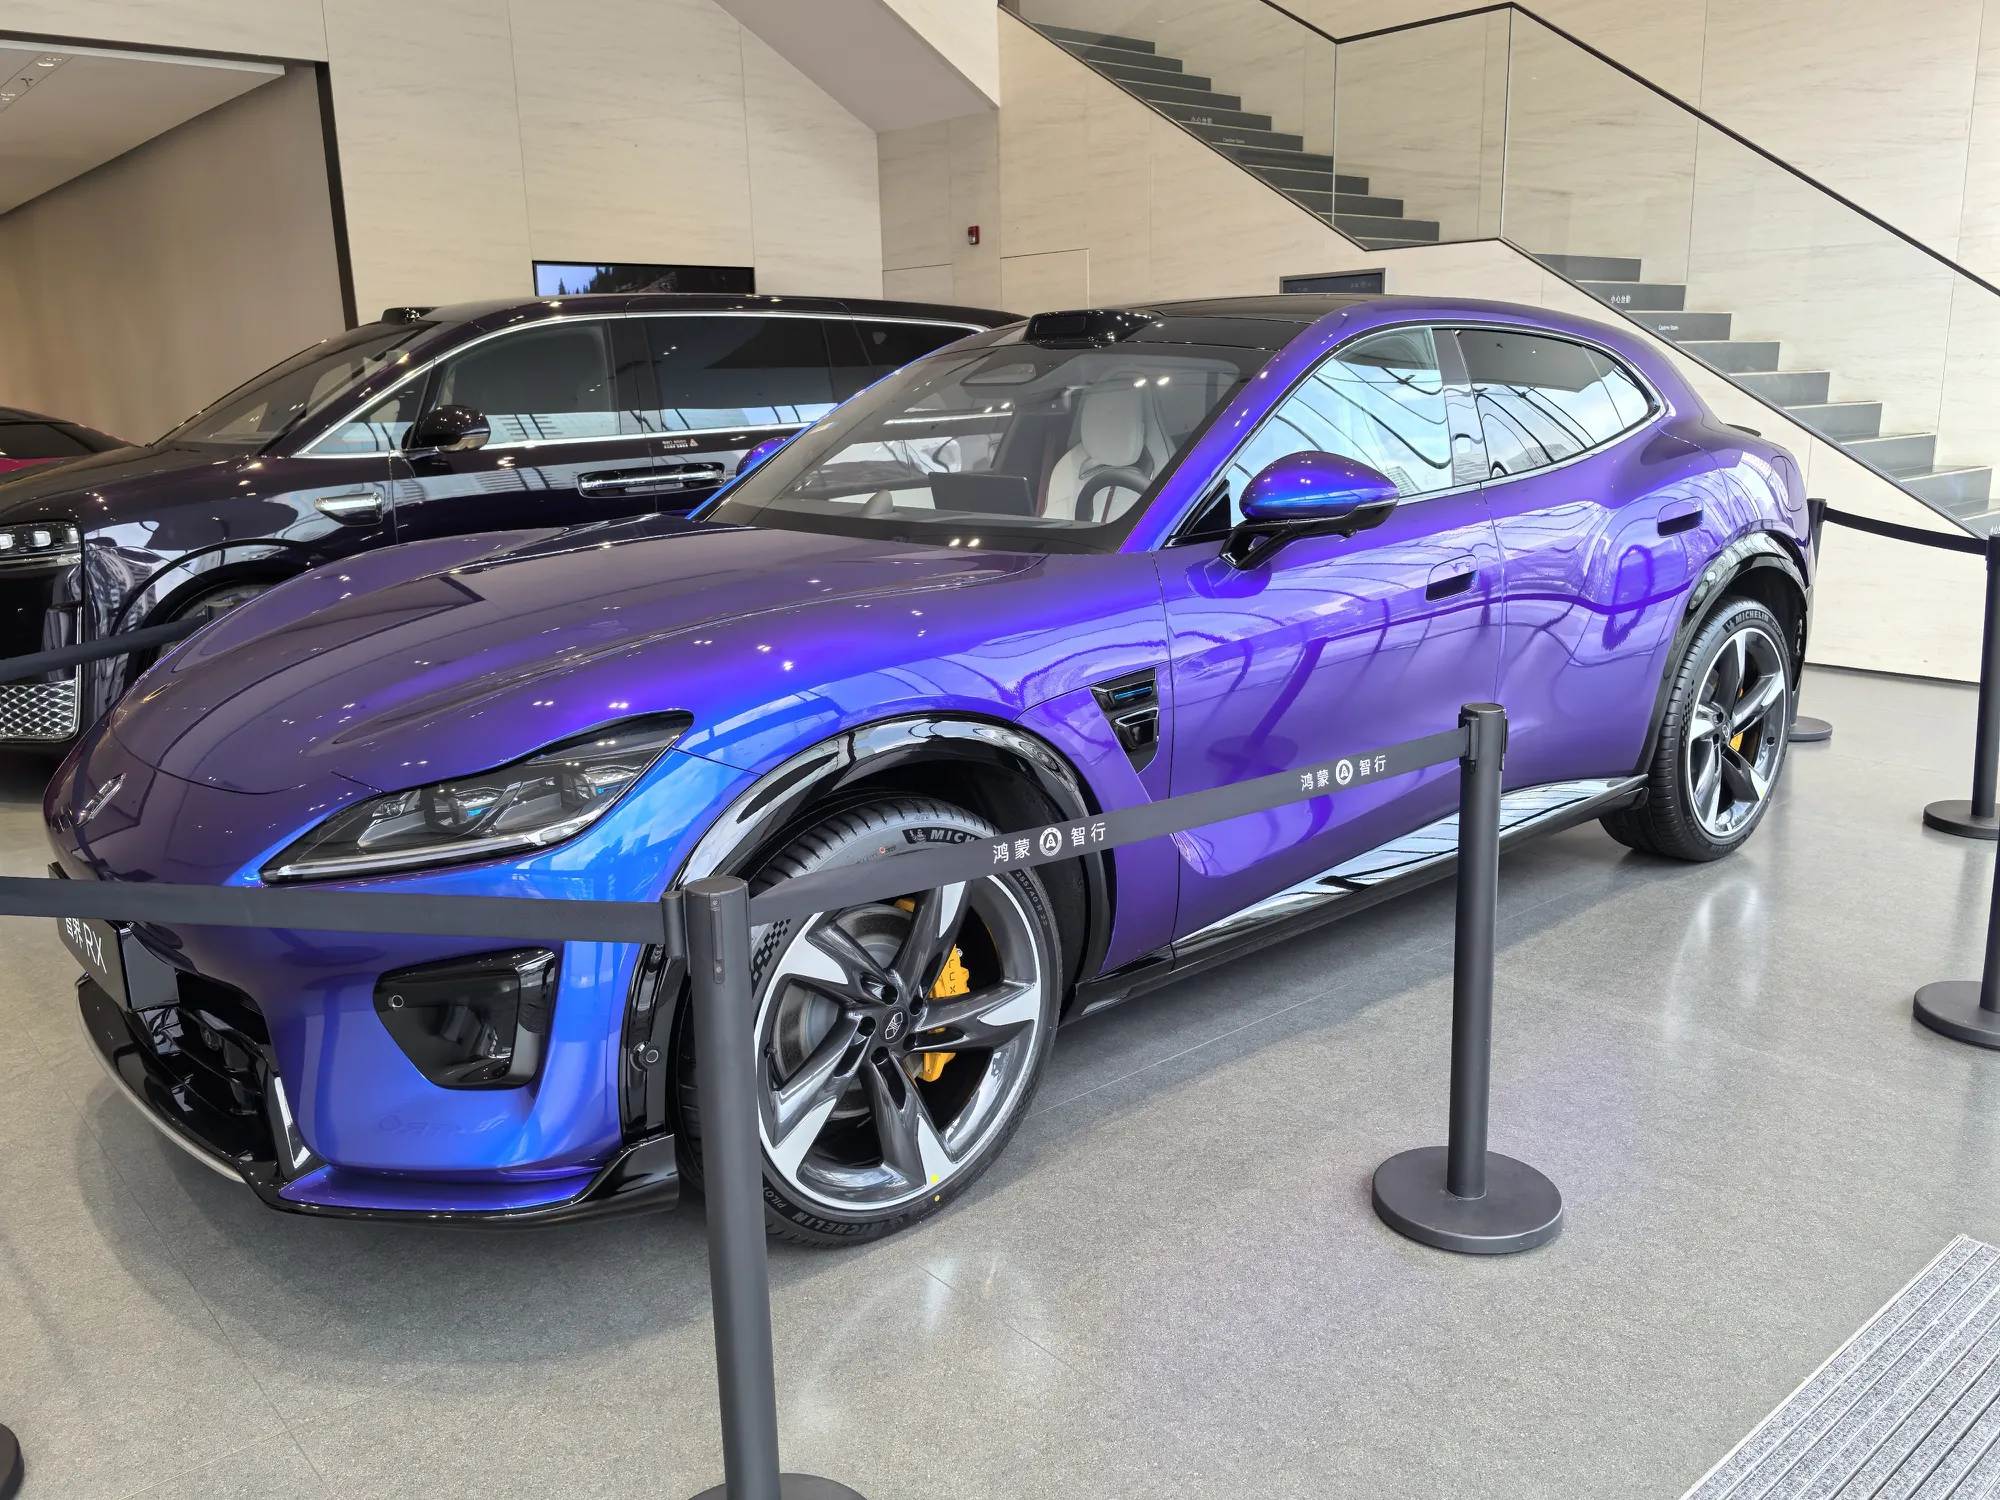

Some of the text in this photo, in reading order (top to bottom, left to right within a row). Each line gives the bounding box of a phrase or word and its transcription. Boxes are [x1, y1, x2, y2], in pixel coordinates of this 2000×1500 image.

[1735, 610, 1769, 625] MICHELIN
[1300, 755, 1387, 791] 鸿蒙 智行
[930, 829, 976, 843] MICH
[993, 822, 1106, 864] 鸿蒙 智行
[83, 922, 107, 974] RX
[791, 1212, 885, 1236] MICHELIN
